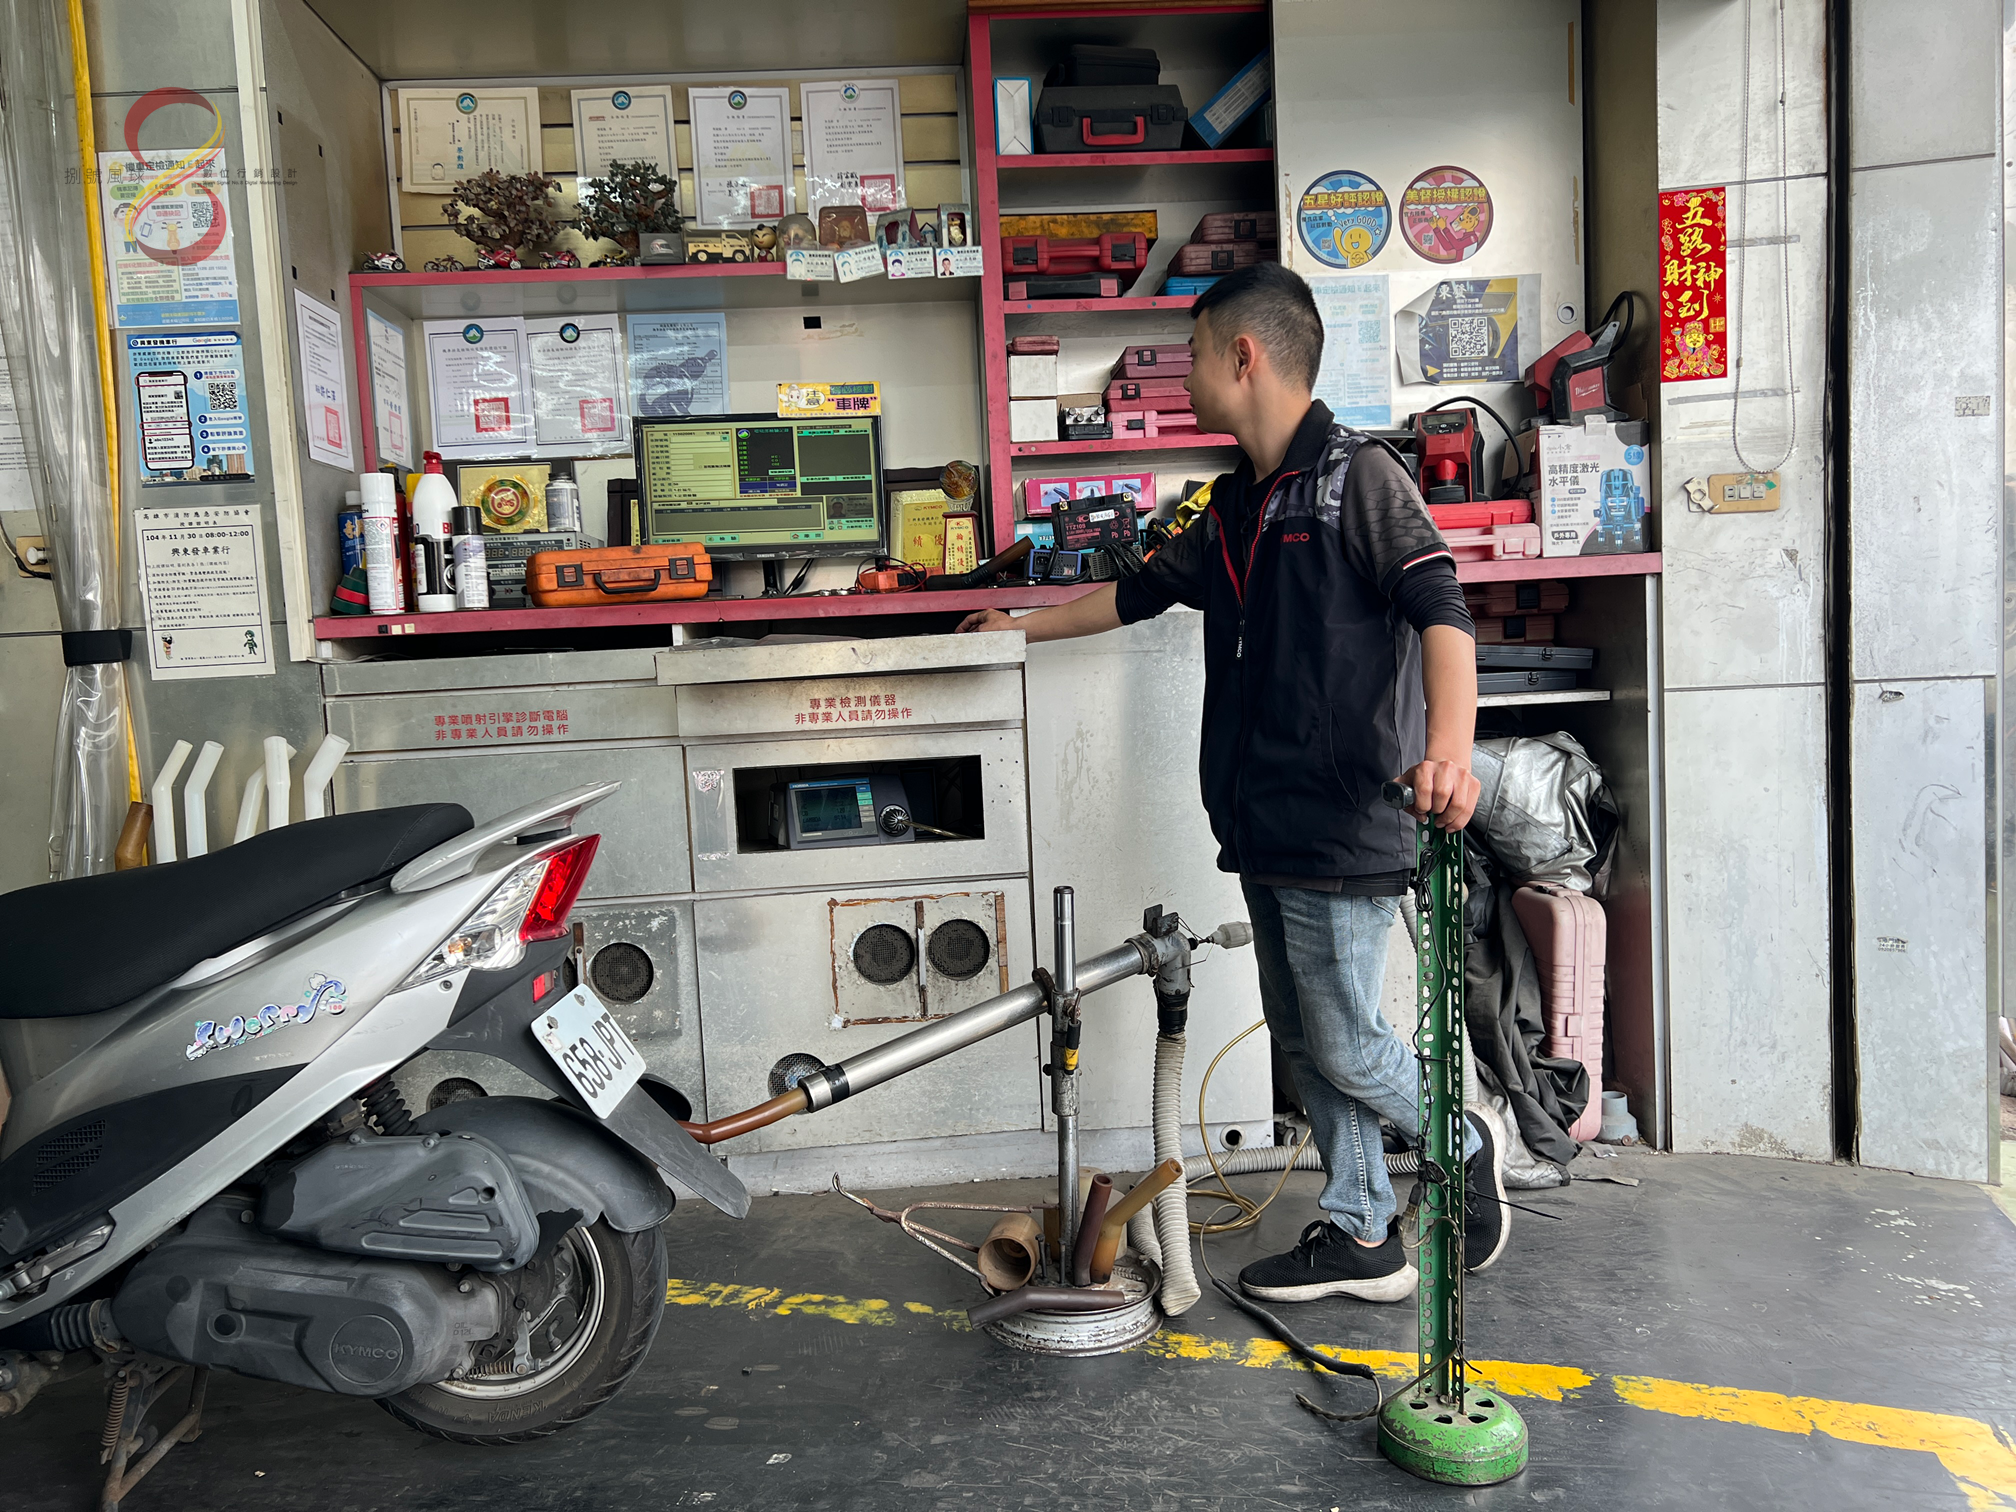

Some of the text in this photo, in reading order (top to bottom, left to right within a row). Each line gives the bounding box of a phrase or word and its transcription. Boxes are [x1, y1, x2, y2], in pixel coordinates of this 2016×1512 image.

[1303, 191, 1385, 209] 五星好評認證
[1340, 215, 1378, 228] Very GOOD
[1663, 196, 1724, 321] 五路財神到
[1313, 284, 1356, 295] 車定檢通知
[1433, 283, 1467, 300] 東發
[1548, 462, 1600, 476] 高精度激光
[1548, 475, 1580, 487] 水平儀
[205, 530, 250, 538] 08:00-12:00
[1123, 529, 1131, 537] Pb
[809, 694, 897, 710] 專業檢測儀器
[434, 709, 569, 727] 專業噴射引擎診斷電腦
[795, 707, 913, 725] 非專業人員請勿操作
[435, 724, 569, 741] 非專業人員請勿操作
[333, 1343, 399, 1360] KYMCO
[487, 1400, 546, 1424] KENDA
